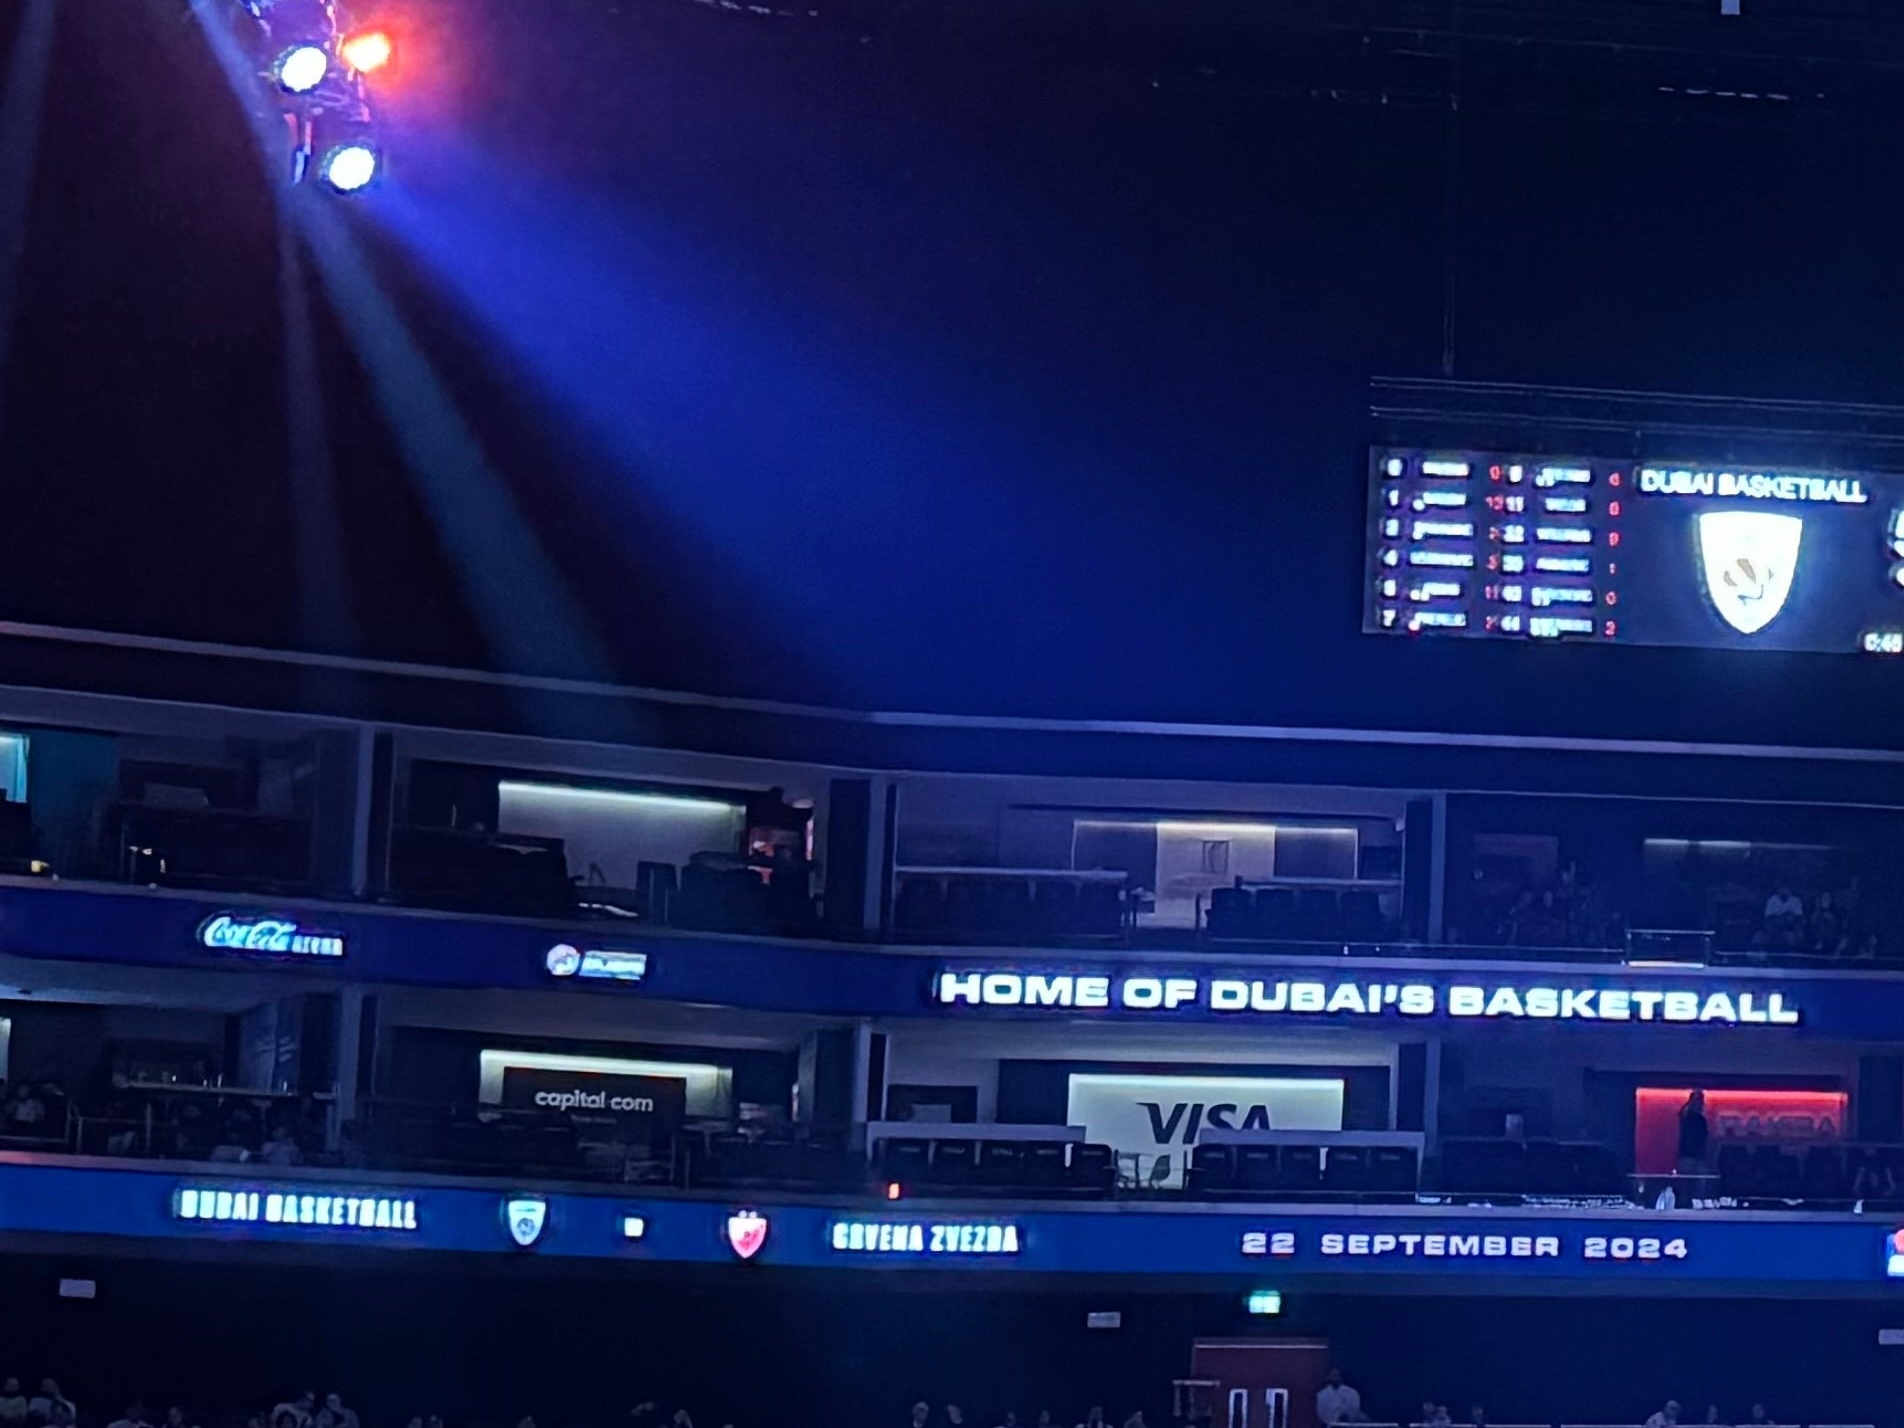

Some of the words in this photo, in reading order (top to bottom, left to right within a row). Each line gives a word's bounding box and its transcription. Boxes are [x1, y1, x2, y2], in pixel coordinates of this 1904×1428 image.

[1641, 469, 1714, 494] DUBAI
[1718, 473, 1866, 502] BASKETBALL
[941, 974, 1108, 1006] HOME
[1123, 979, 1196, 1008] OF
[1211, 981, 1434, 1013] DUBAI'S
[1450, 987, 1798, 1022] BASKETBALL
[1136, 1102, 1272, 1142] VISA
[266, 1195, 416, 1228] BASKETBALL
[1243, 1233, 1294, 1253] 22
[1322, 1234, 1558, 1256] SEPTEMBER
[1585, 1238, 1687, 1258] 2024
